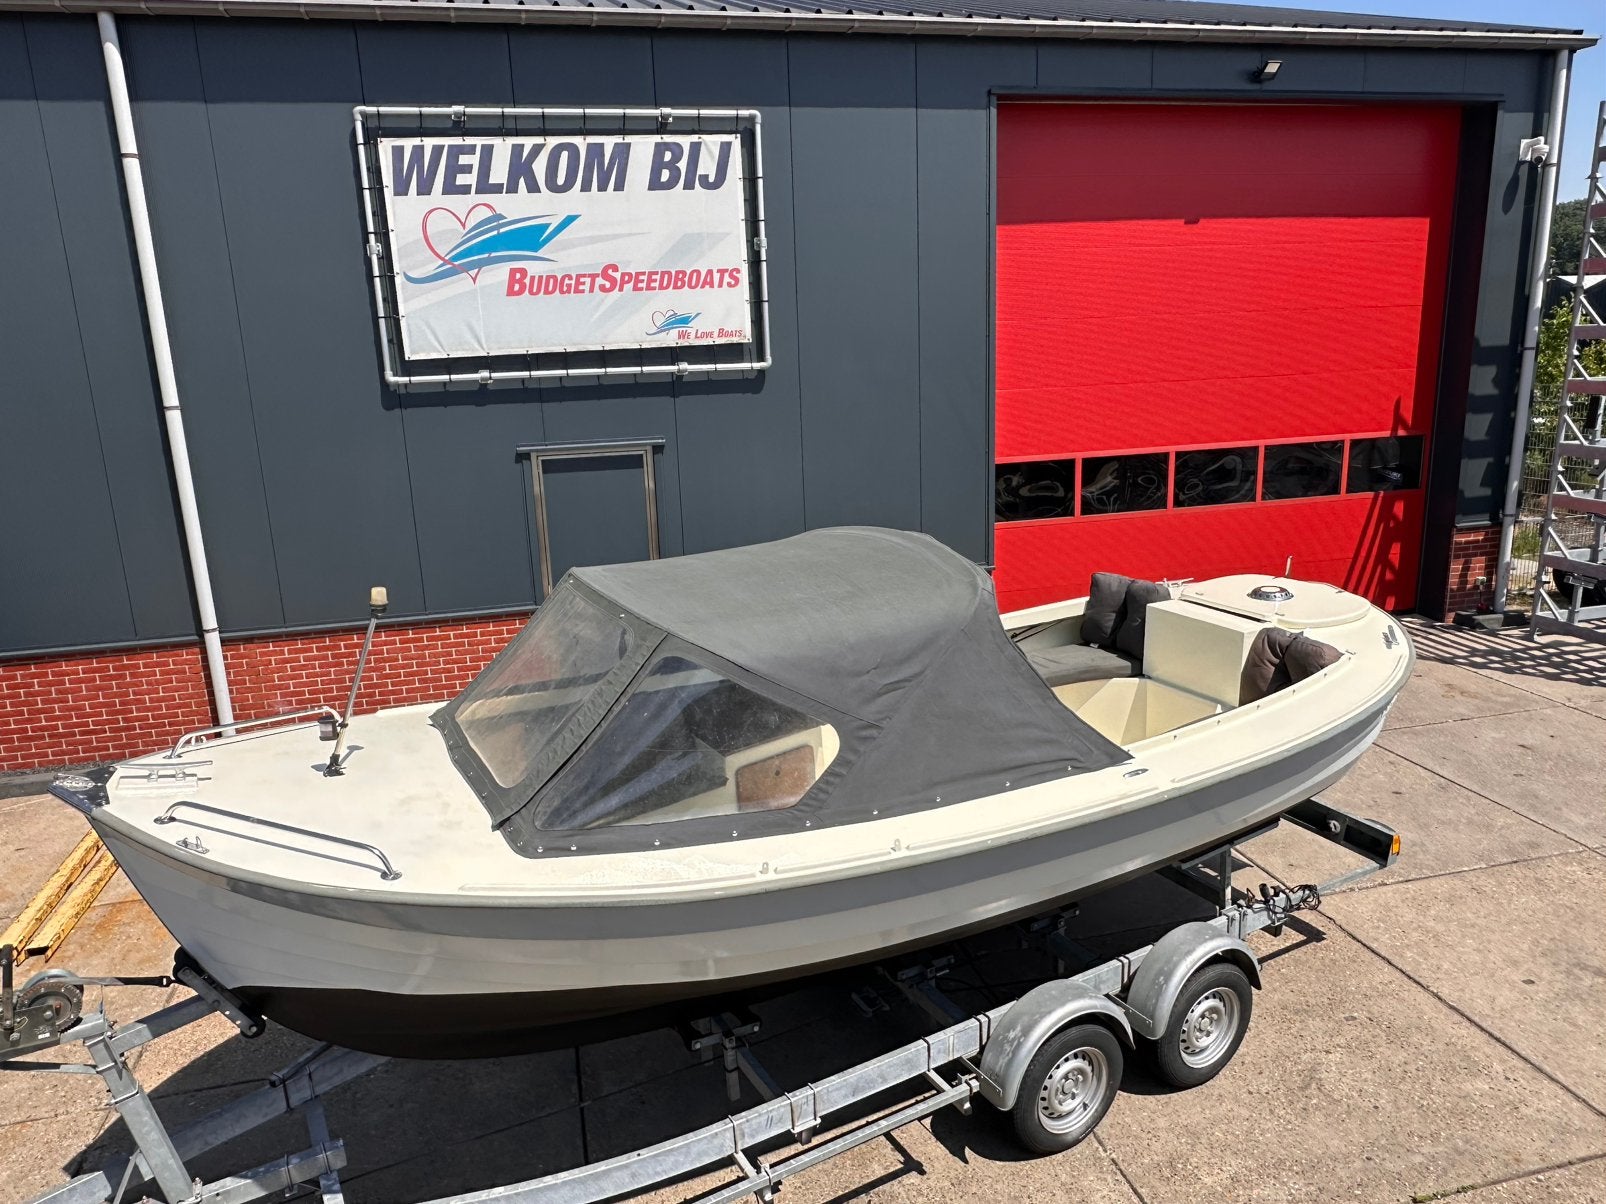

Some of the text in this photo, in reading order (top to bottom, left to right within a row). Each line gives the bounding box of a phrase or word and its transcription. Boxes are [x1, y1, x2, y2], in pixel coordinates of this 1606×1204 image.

[391, 141, 733, 196] WELKOM BIJ
[677, 329, 692, 340] WE
[694, 329, 715, 339] LOVE
